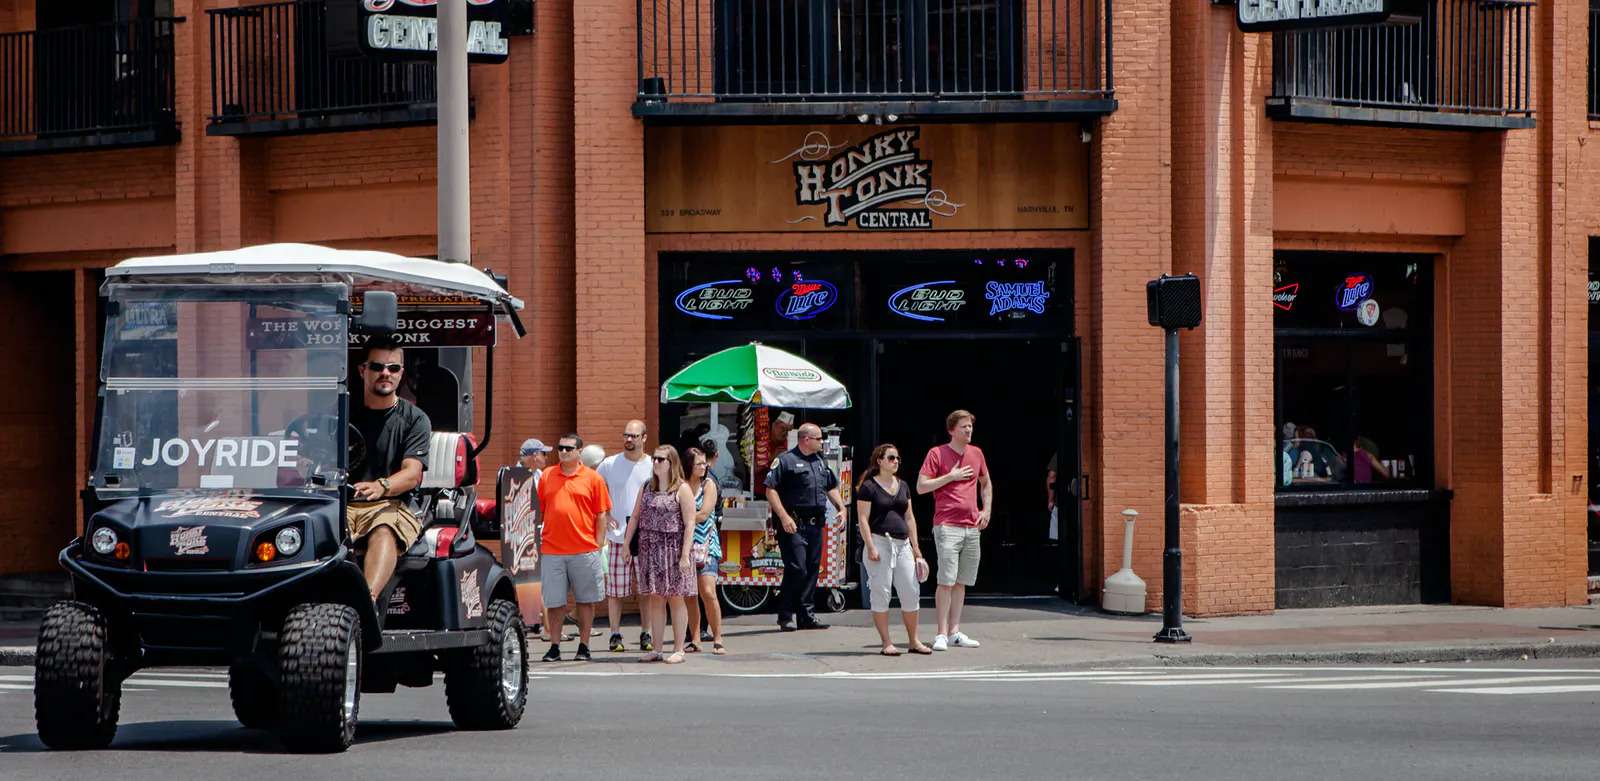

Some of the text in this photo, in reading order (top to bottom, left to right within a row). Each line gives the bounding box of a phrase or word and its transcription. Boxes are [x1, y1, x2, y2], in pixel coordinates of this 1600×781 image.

[368, 13, 508, 55] CENTAL
[797, 130, 916, 201] HONKY
[818, 164, 928, 223] TONK
[859, 212, 930, 227] CENTRAL
[699, 288, 752, 299] BUD
[911, 288, 965, 300] BUD
[985, 281, 1050, 299] SAMUEL
[686, 299, 754, 310] LIGHT
[785, 291, 829, 316] Lite
[898, 300, 966, 311] LIGHT
[990, 296, 1046, 315] ADAMS
[262, 321, 298, 332] THE
[396, 319, 478, 329] BIGGEST
[392, 333, 431, 344] ONK
[142, 438, 299, 467] JOYRIDE
